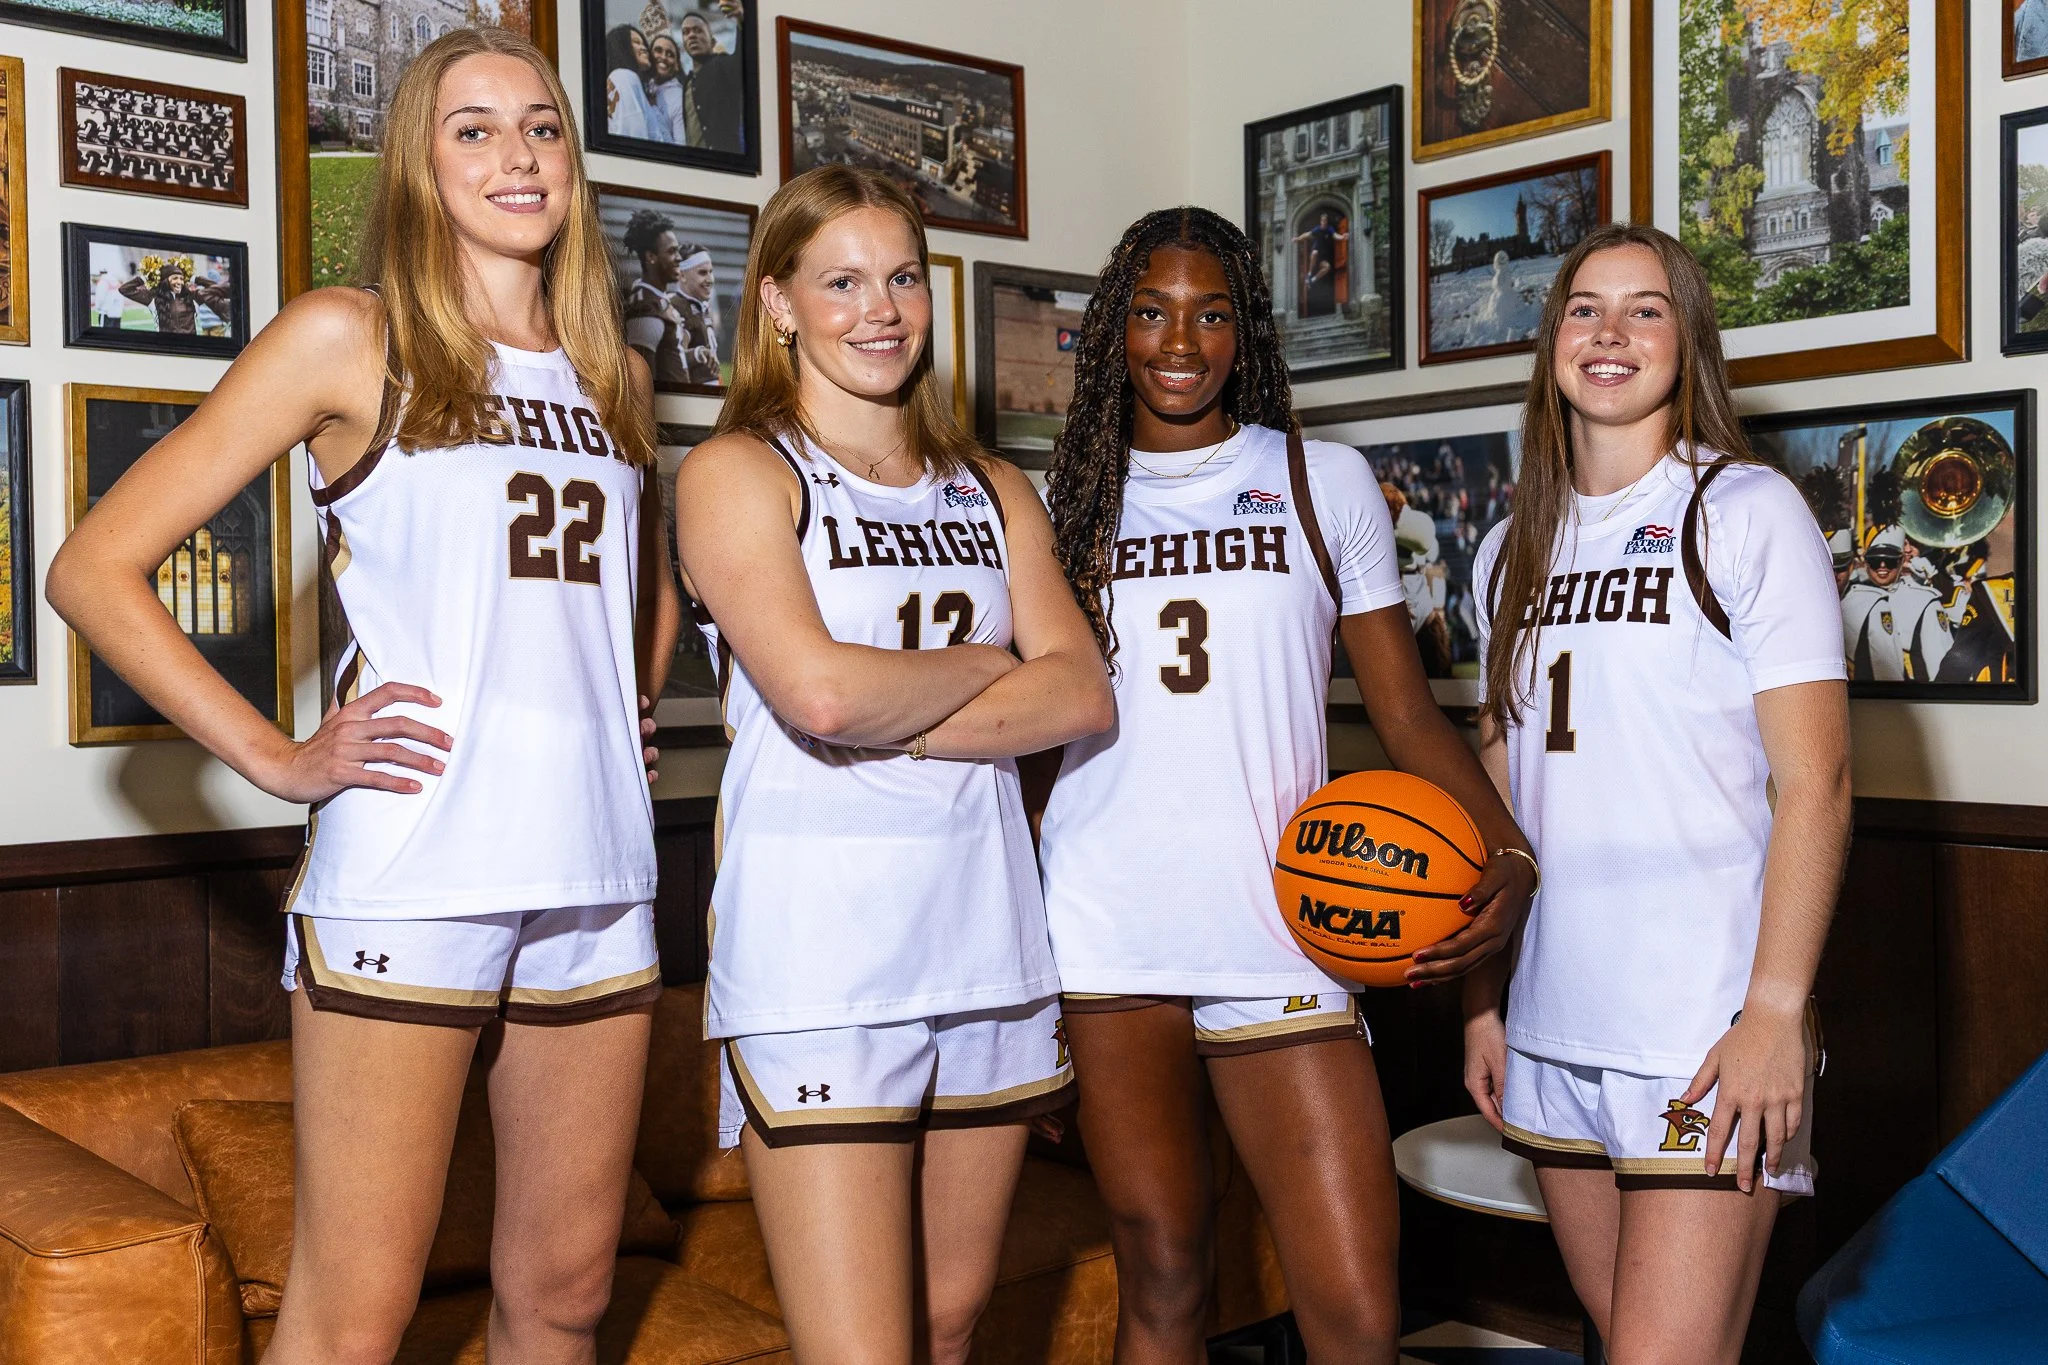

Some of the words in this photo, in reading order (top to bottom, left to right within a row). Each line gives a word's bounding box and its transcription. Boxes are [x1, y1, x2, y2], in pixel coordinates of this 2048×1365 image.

[905, 104, 939, 119] LEHIGH
[438, 393, 634, 469] EHIG
[505, 470, 607, 587] 22
[1233, 501, 1287, 511] PATRIOT
[1233, 507, 1287, 516] LEAGUE
[822, 515, 1004, 571] LEHIGH
[1112, 525, 1291, 581] EHIGH
[1623, 545, 1674, 555] LEAGUE
[1625, 536, 1677, 549] PATRIOT
[1518, 567, 1674, 630] HIGH
[1158, 597, 1211, 696] 3
[1545, 650, 1577, 754] 1
[1296, 819, 1430, 880] Wilson
[1336, 936, 1369, 948] GAME
[1370, 940, 1401, 948] BALL
